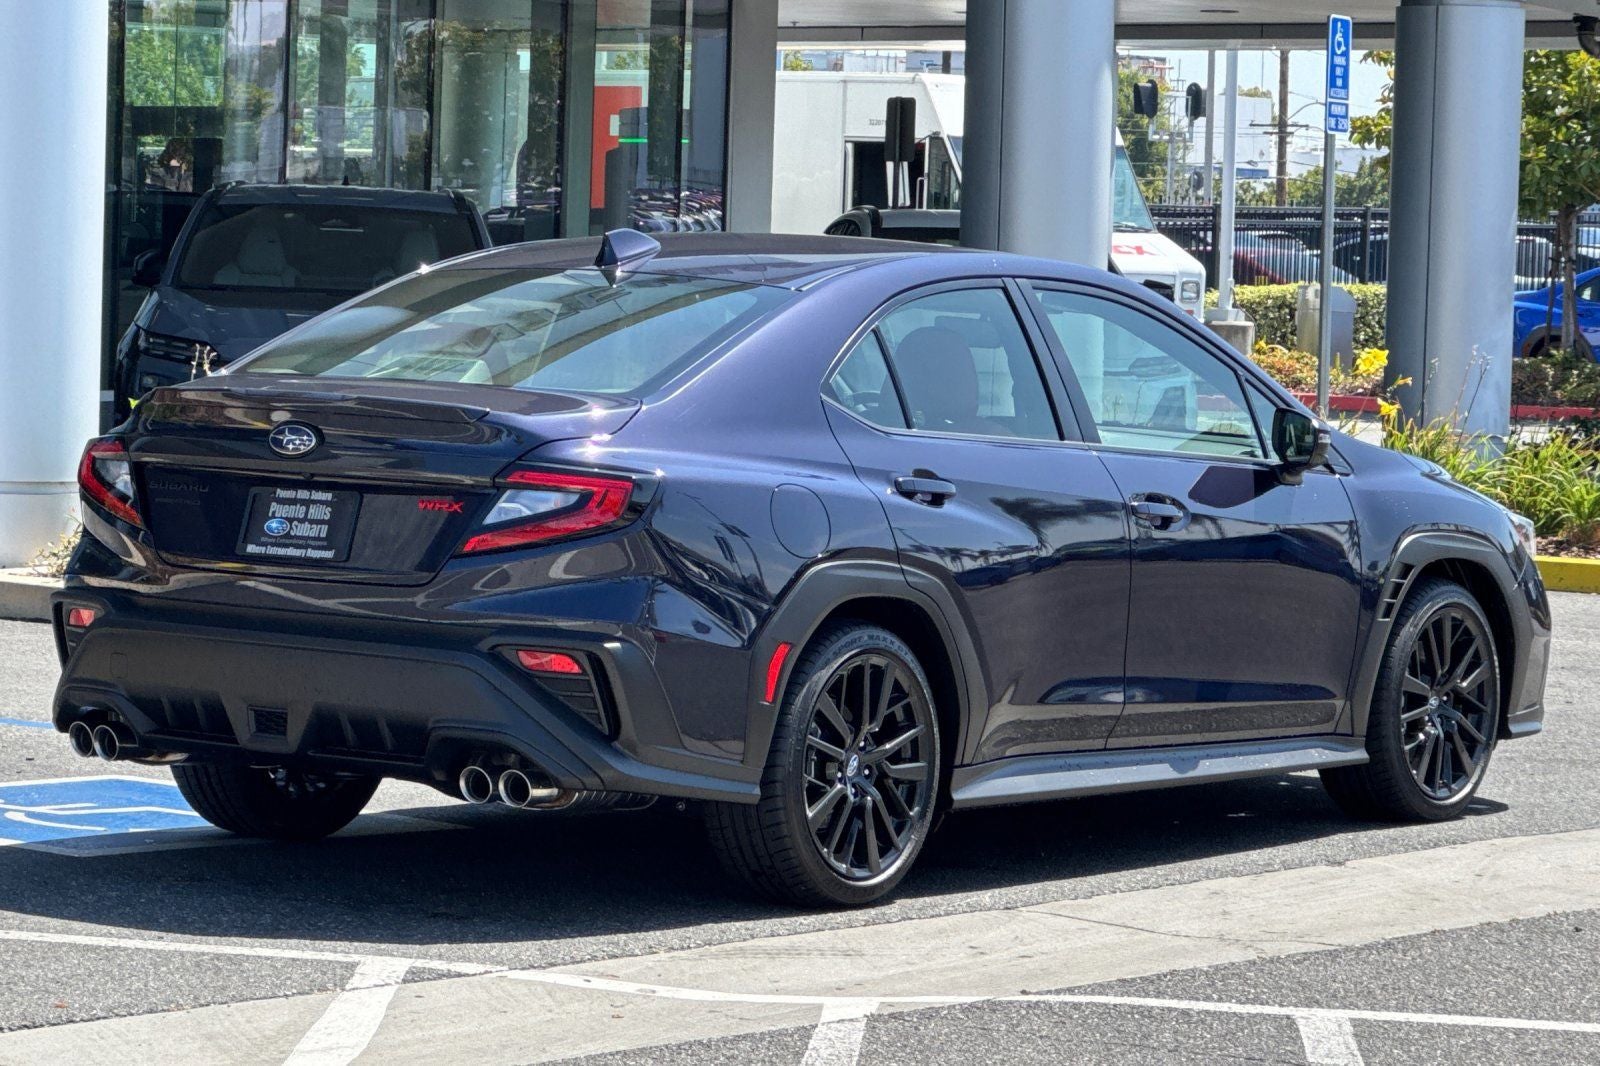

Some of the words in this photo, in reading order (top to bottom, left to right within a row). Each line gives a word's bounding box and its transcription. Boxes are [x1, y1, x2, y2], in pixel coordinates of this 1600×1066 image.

[149, 480, 208, 492] SUBARU
[276, 488, 296, 499] Puente
[296, 489, 311, 500] Hills
[311, 490, 333, 501] Subaru
[269, 502, 305, 518] Puente
[307, 503, 332, 520] Hills
[417, 499, 464, 513] WRX
[290, 521, 328, 538] Subaru
[246, 544, 266, 554] Where
[266, 545, 306, 557] Extraordinary
[306, 547, 335, 559] Happens!
